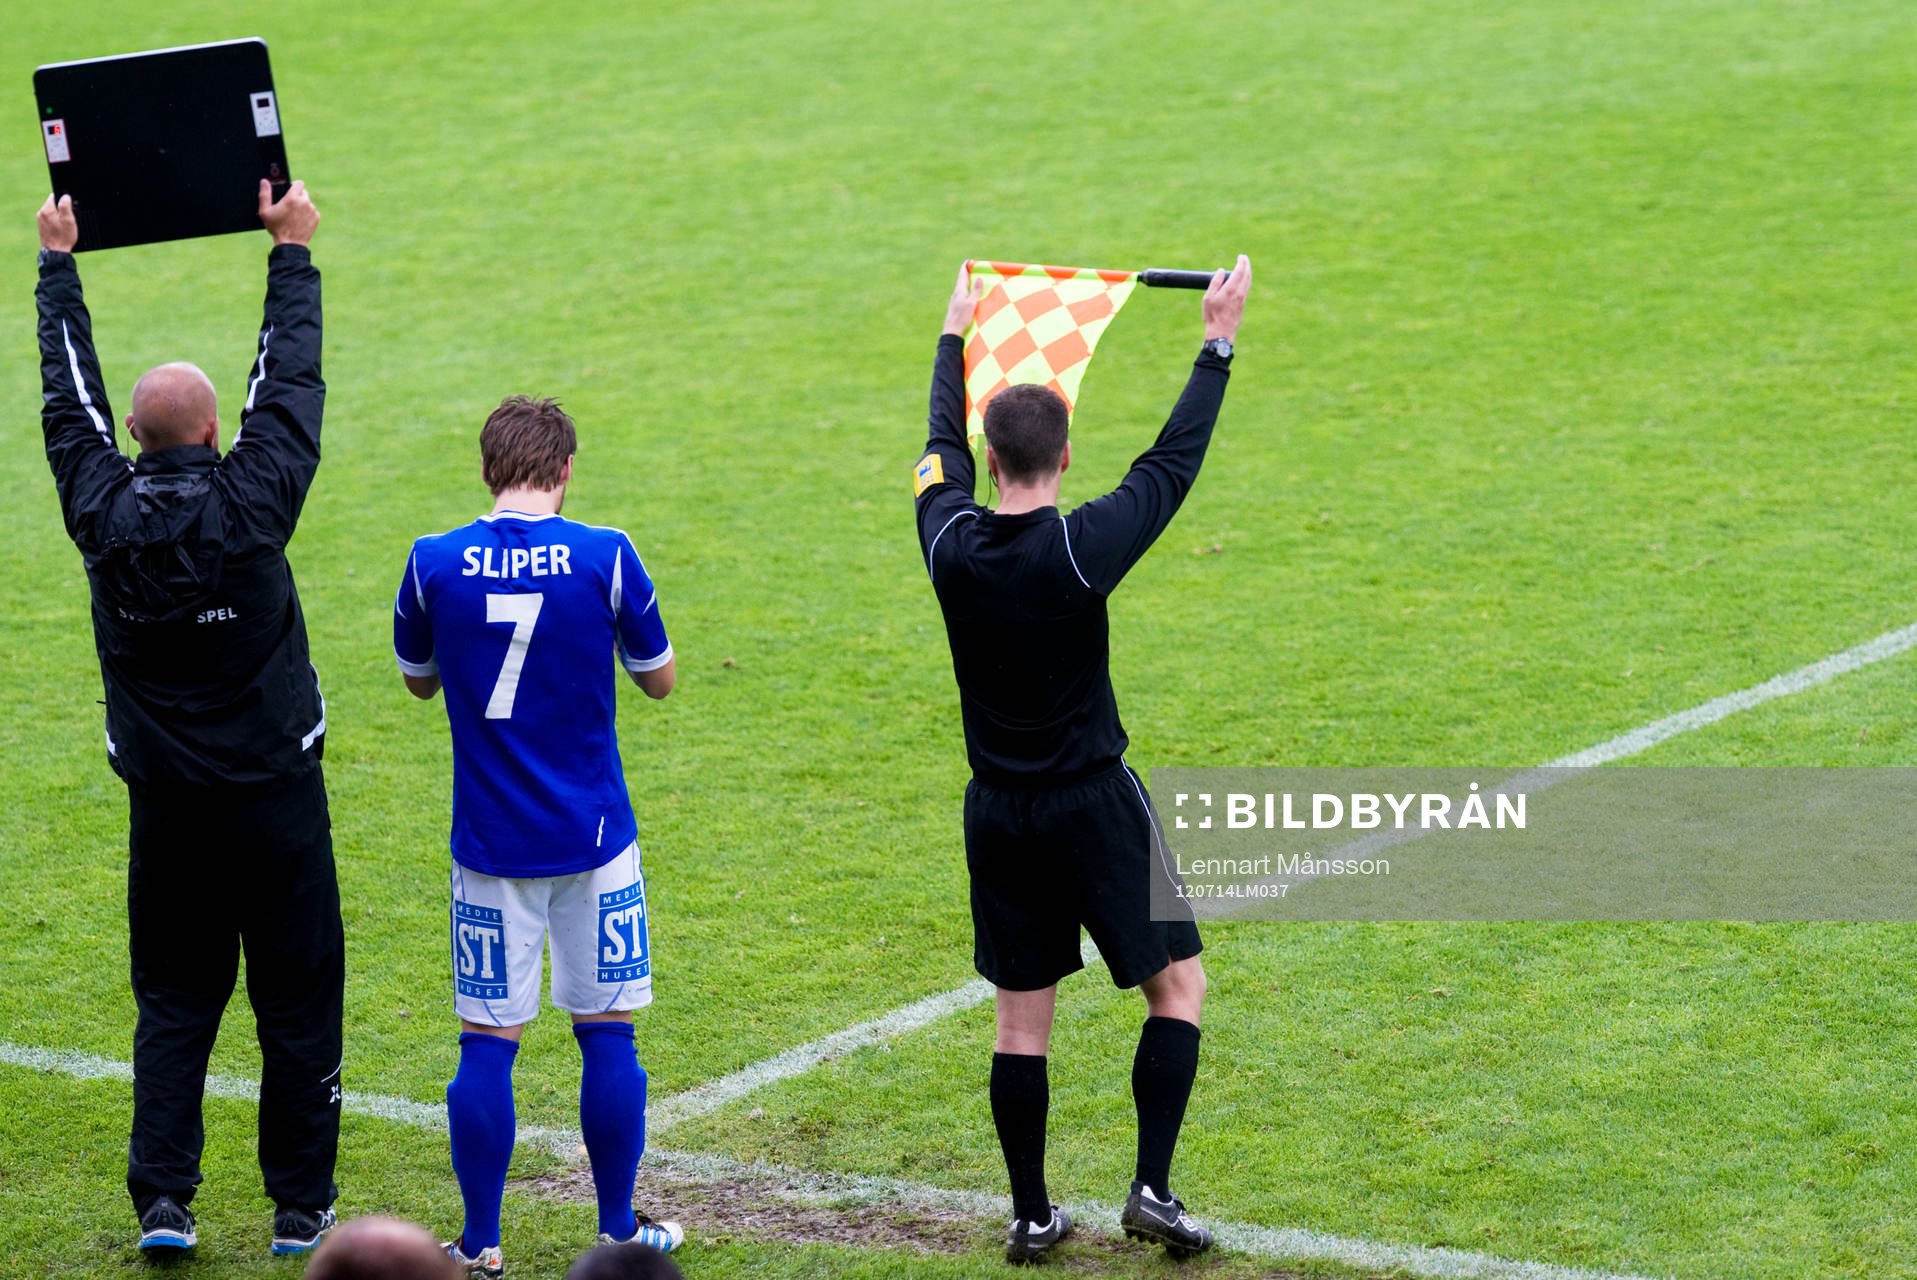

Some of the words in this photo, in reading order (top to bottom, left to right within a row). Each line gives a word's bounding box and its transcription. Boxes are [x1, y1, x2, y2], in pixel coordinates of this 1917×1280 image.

[462, 544, 572, 579] SLIPER
[197, 607, 237, 624] SPEL
[485, 592, 544, 719] 7
[603, 885, 640, 905] MEDIE
[604, 903, 643, 963] ST
[458, 923, 499, 979] ST
[602, 964, 648, 980] HUSET
